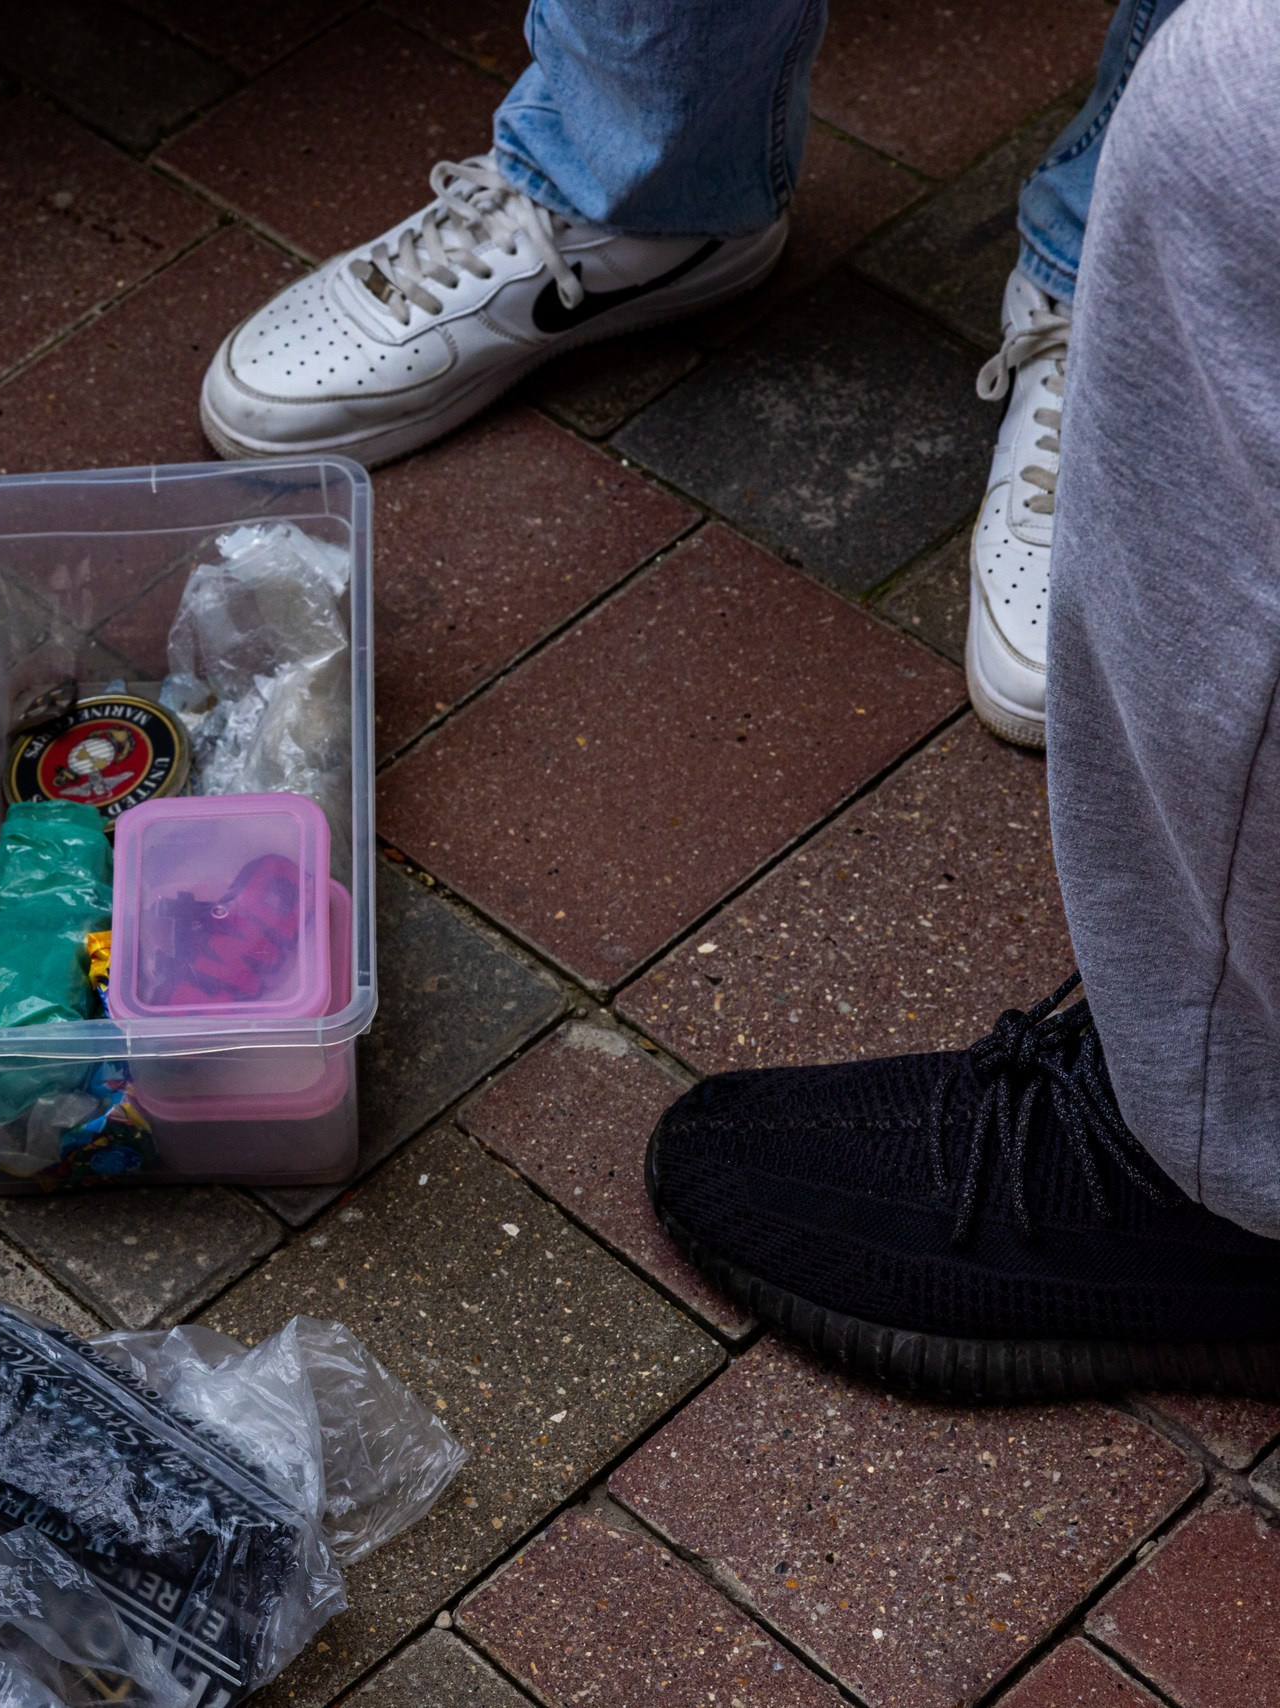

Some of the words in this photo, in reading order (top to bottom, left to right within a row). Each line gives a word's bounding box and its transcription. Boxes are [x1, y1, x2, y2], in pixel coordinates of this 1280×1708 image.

[79, 704, 153, 726] MARINE
[107, 756, 171, 816] UNITED
[61, 1385, 165, 1448] Street
